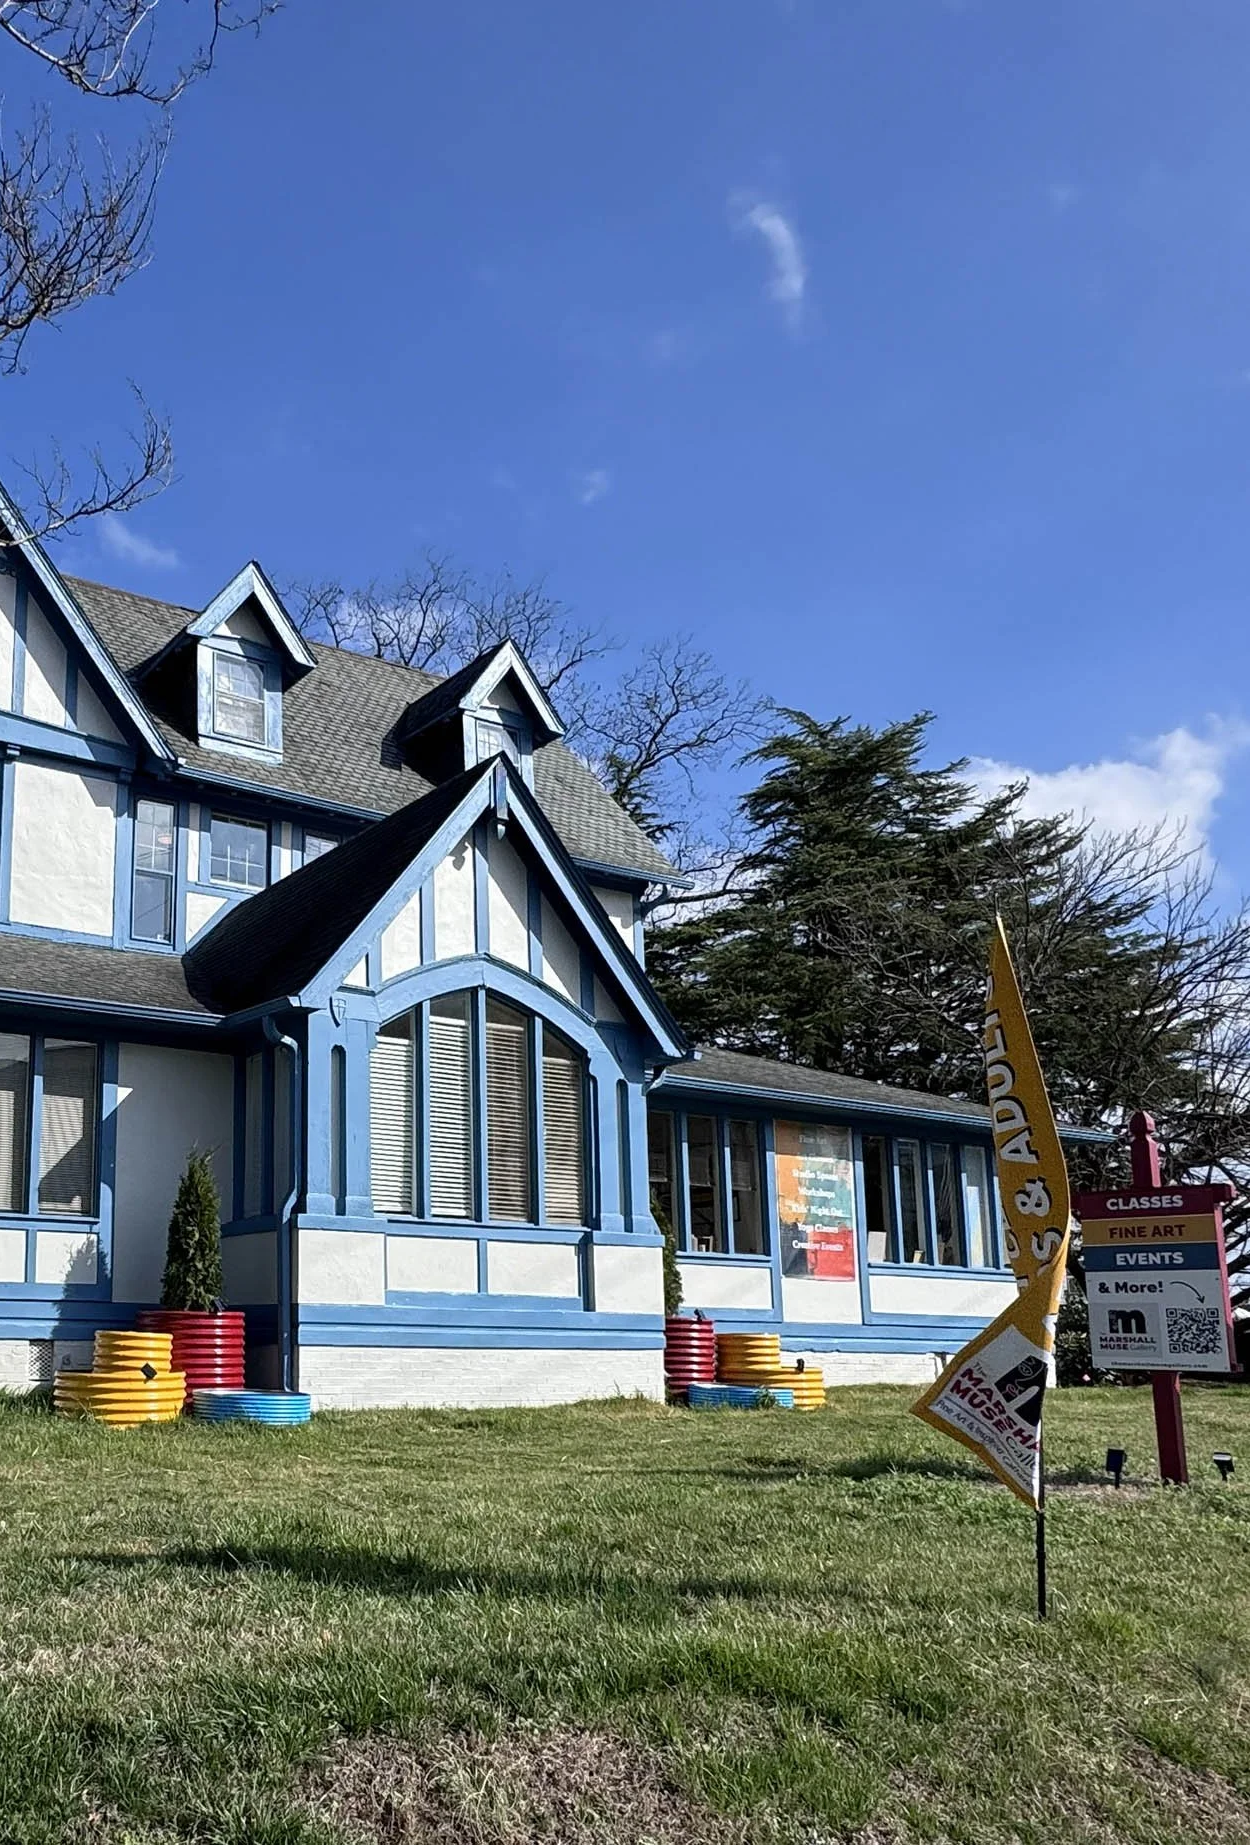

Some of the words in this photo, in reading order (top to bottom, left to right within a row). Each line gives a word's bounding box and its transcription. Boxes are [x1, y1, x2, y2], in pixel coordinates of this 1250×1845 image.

[985, 974, 1039, 1165] ADUL
[1014, 1178, 1051, 1218] &
[1106, 1195, 1184, 1210] CLASSES
[1108, 1226, 1147, 1239] FINE
[1151, 1224, 1187, 1237] ART
[1115, 1252, 1184, 1266] EVENTS
[1098, 1282, 1110, 1294] &
[1114, 1281, 1163, 1294] More!
[1099, 1336, 1157, 1344] MARSHALL
[1100, 1343, 1128, 1351] MUSE
[936, 1400, 955, 1415] Fine
[953, 1412, 967, 1424] Art
[960, 1368, 1040, 1450] MARSHA
[950, 1379, 1007, 1435] MUSE
[1005, 1436, 1037, 1470] Gall
